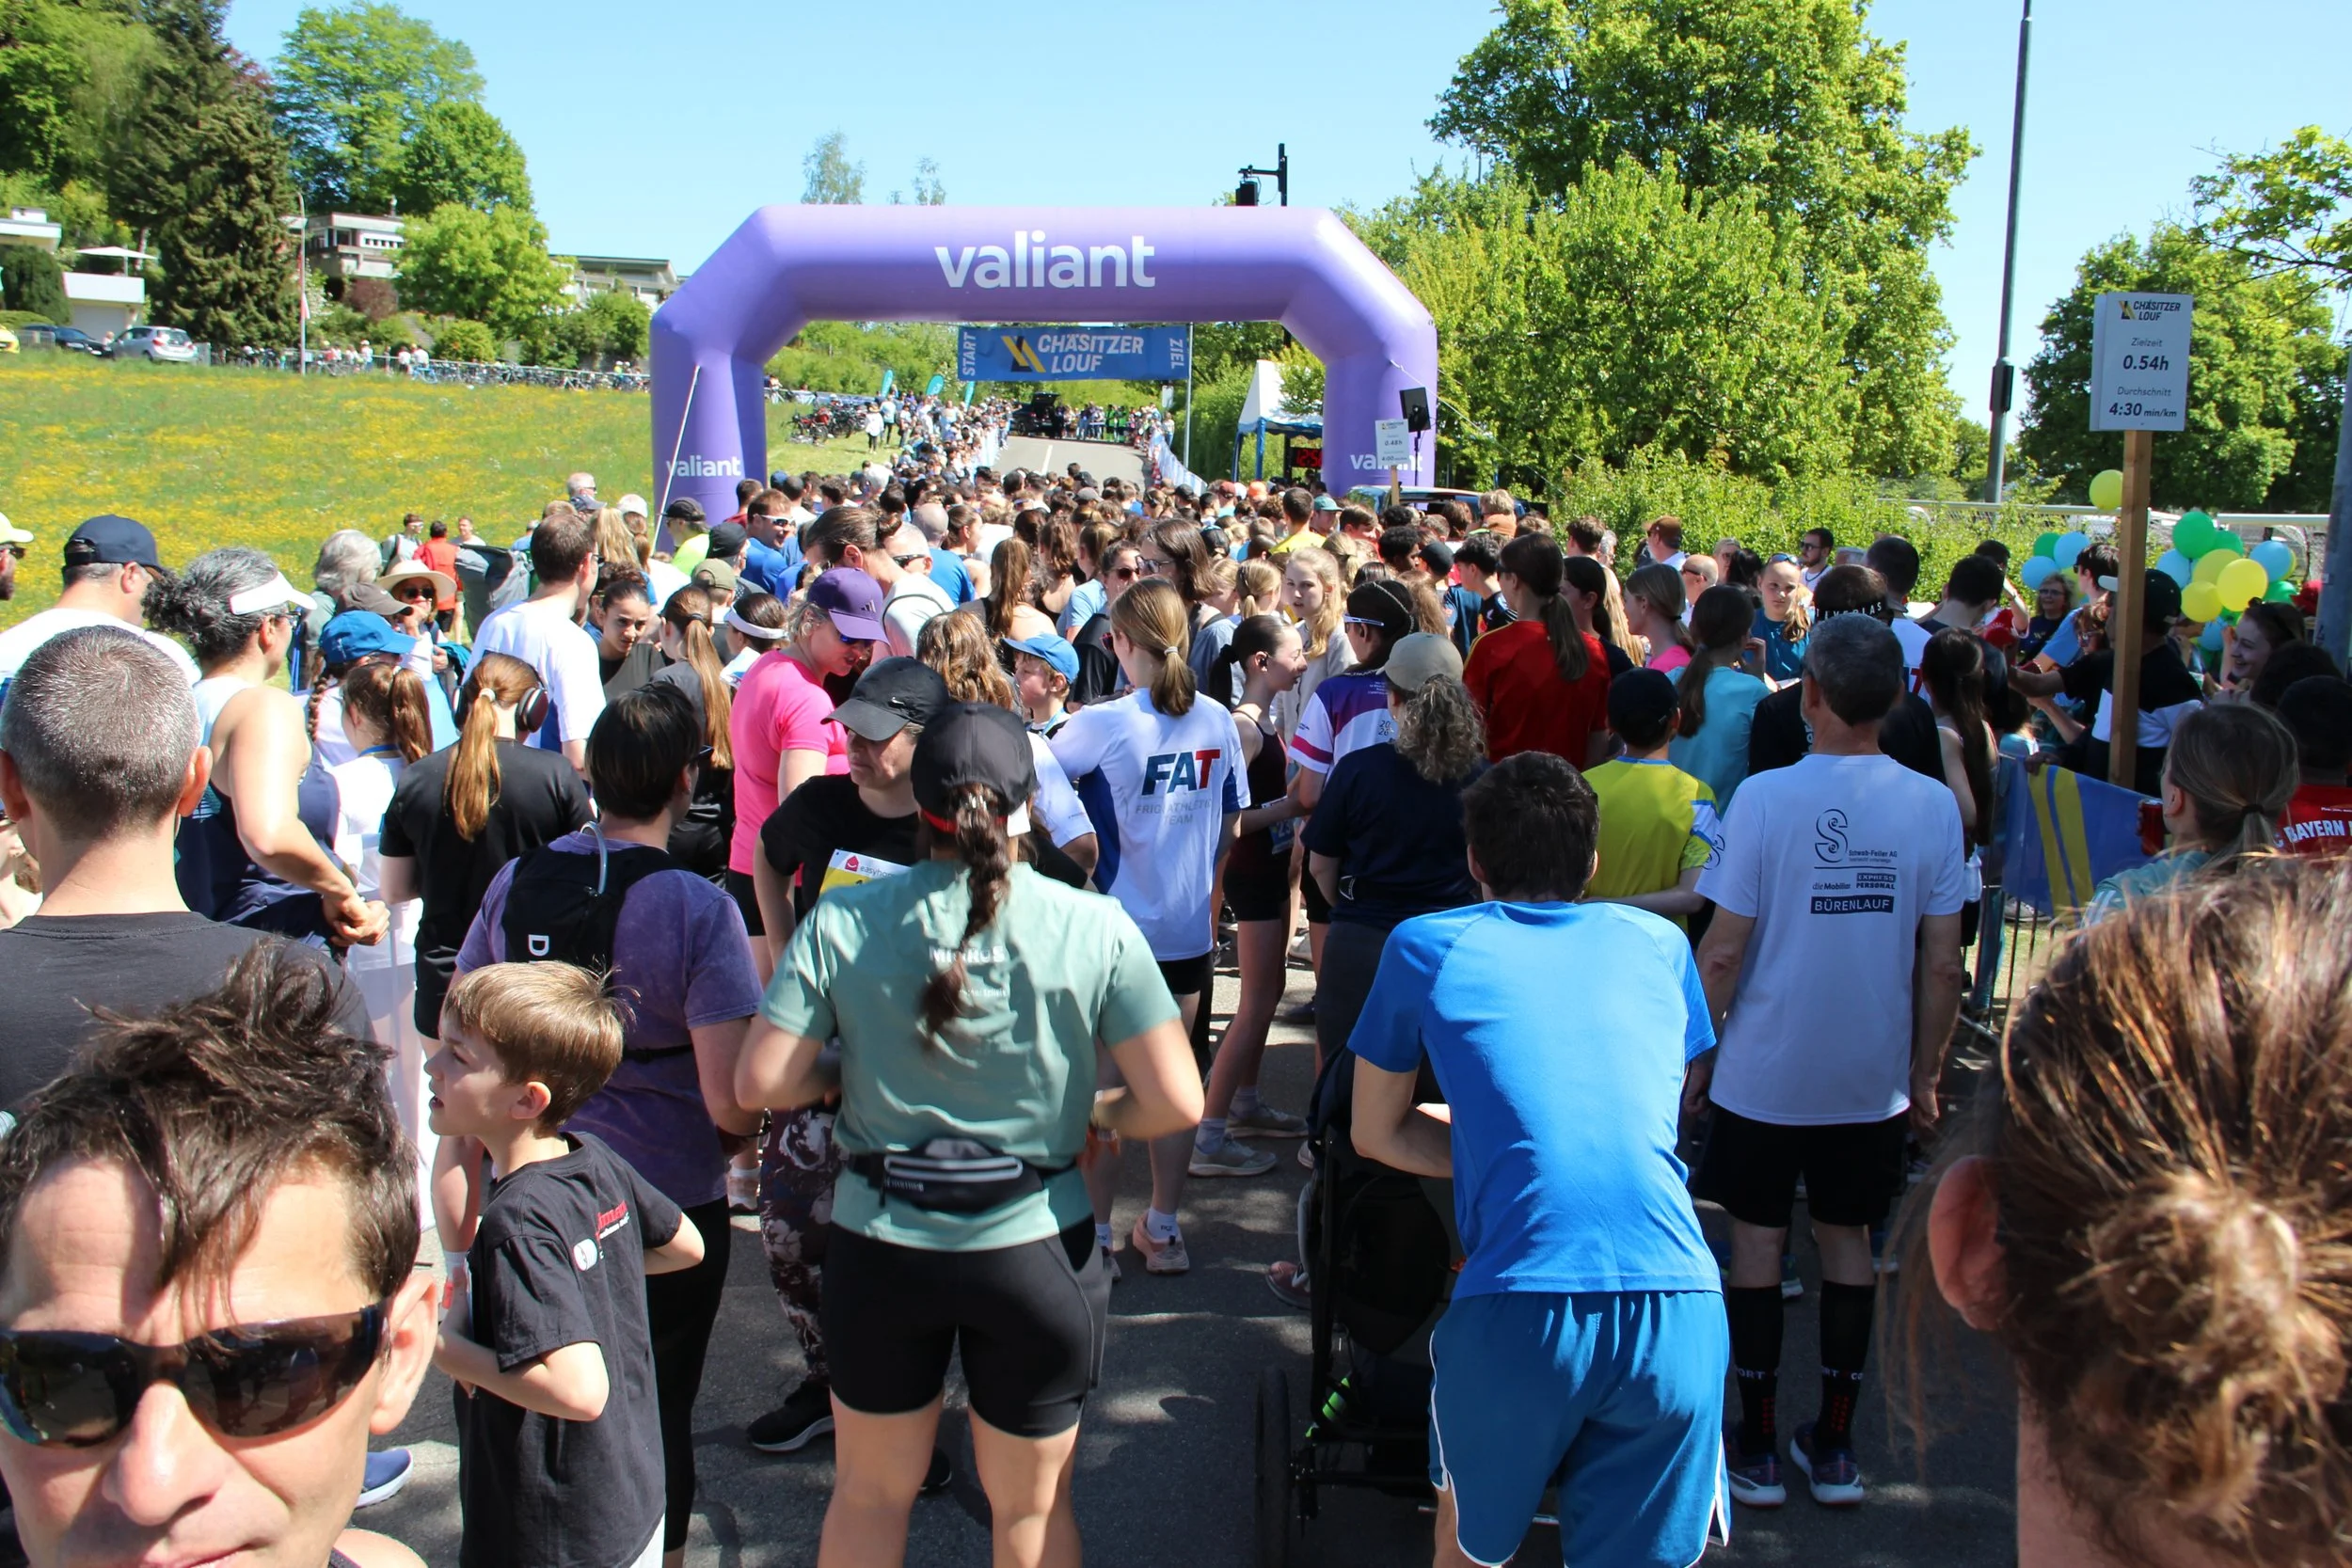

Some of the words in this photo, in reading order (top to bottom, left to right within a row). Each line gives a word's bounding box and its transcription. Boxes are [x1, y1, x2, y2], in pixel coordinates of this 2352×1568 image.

[934, 230, 1155, 289] valiant
[2134, 299, 2181, 311] CHÄSITZER
[2138, 311, 2162, 321] LOUF
[1038, 334, 1144, 354] CHÄSITZER
[2131, 338, 2163, 347] Zielzeit
[961, 332, 977, 376] START
[1169, 338, 1184, 370] ZIEL
[1051, 355, 1103, 374] LOUF
[2122, 355, 2169, 371] 0.54h
[2117, 387, 2171, 396] Durchschnitt
[2109, 403, 2142, 416] 4:30
[2144, 408, 2177, 418] min/km
[1141, 749, 1221, 796] FAT
[2283, 820, 2345, 843] BAYERN
[1814, 898, 1890, 911] BÜRENLAUF
